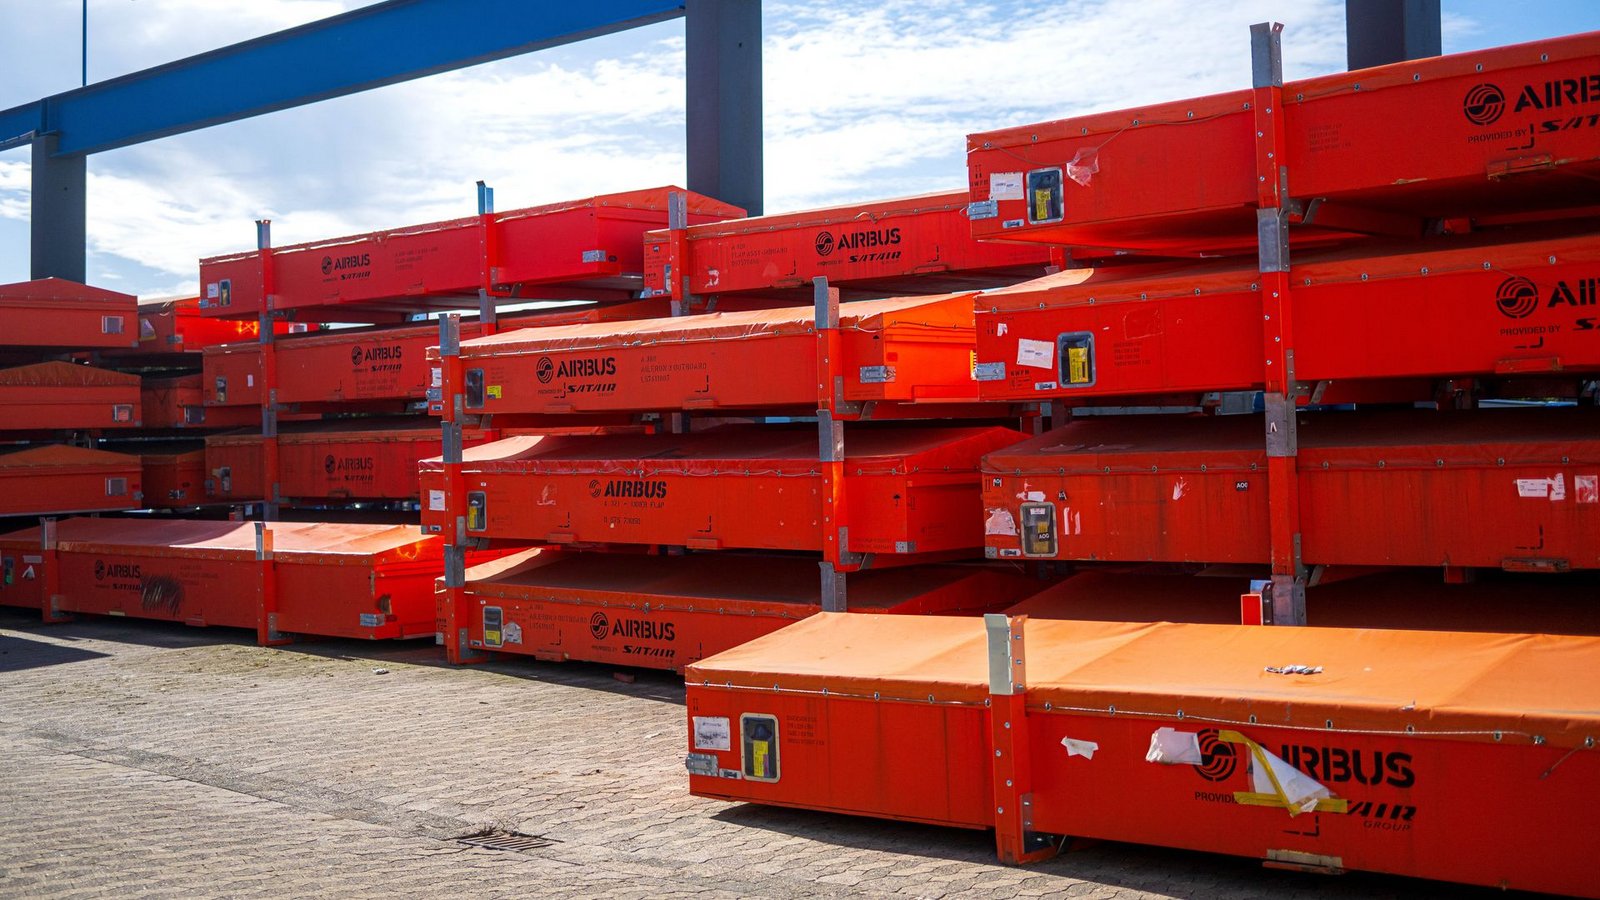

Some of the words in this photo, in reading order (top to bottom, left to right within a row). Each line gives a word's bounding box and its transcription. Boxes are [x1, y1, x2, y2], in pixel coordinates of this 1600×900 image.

[1467, 130, 1513, 143] PROVIDED
[1514, 128, 1527, 138] BY
[838, 228, 901, 249] AIRBUS
[334, 253, 370, 270] AIRBUS
[848, 252, 901, 263] SATAIR
[1500, 325, 1546, 336] PROVIDED
[1548, 324, 1561, 333] BY
[1573, 317, 1600, 331] S
[365, 345, 402, 361] AIRBUS
[557, 357, 616, 378] AIRBUS
[566, 383, 616, 393] SATAIR
[337, 457, 374, 471] AIRBUS
[604, 480, 667, 499] AIRBUS
[106, 564, 140, 578] AIRBUS
[612, 618, 675, 641] AIRBUS
[623, 645, 675, 657] SATAIR
[1281, 743, 1415, 789] RBUS
[1195, 790, 1239, 805] PROVID
[1347, 800, 1417, 822] AIR
[1363, 820, 1412, 832] GROUP
